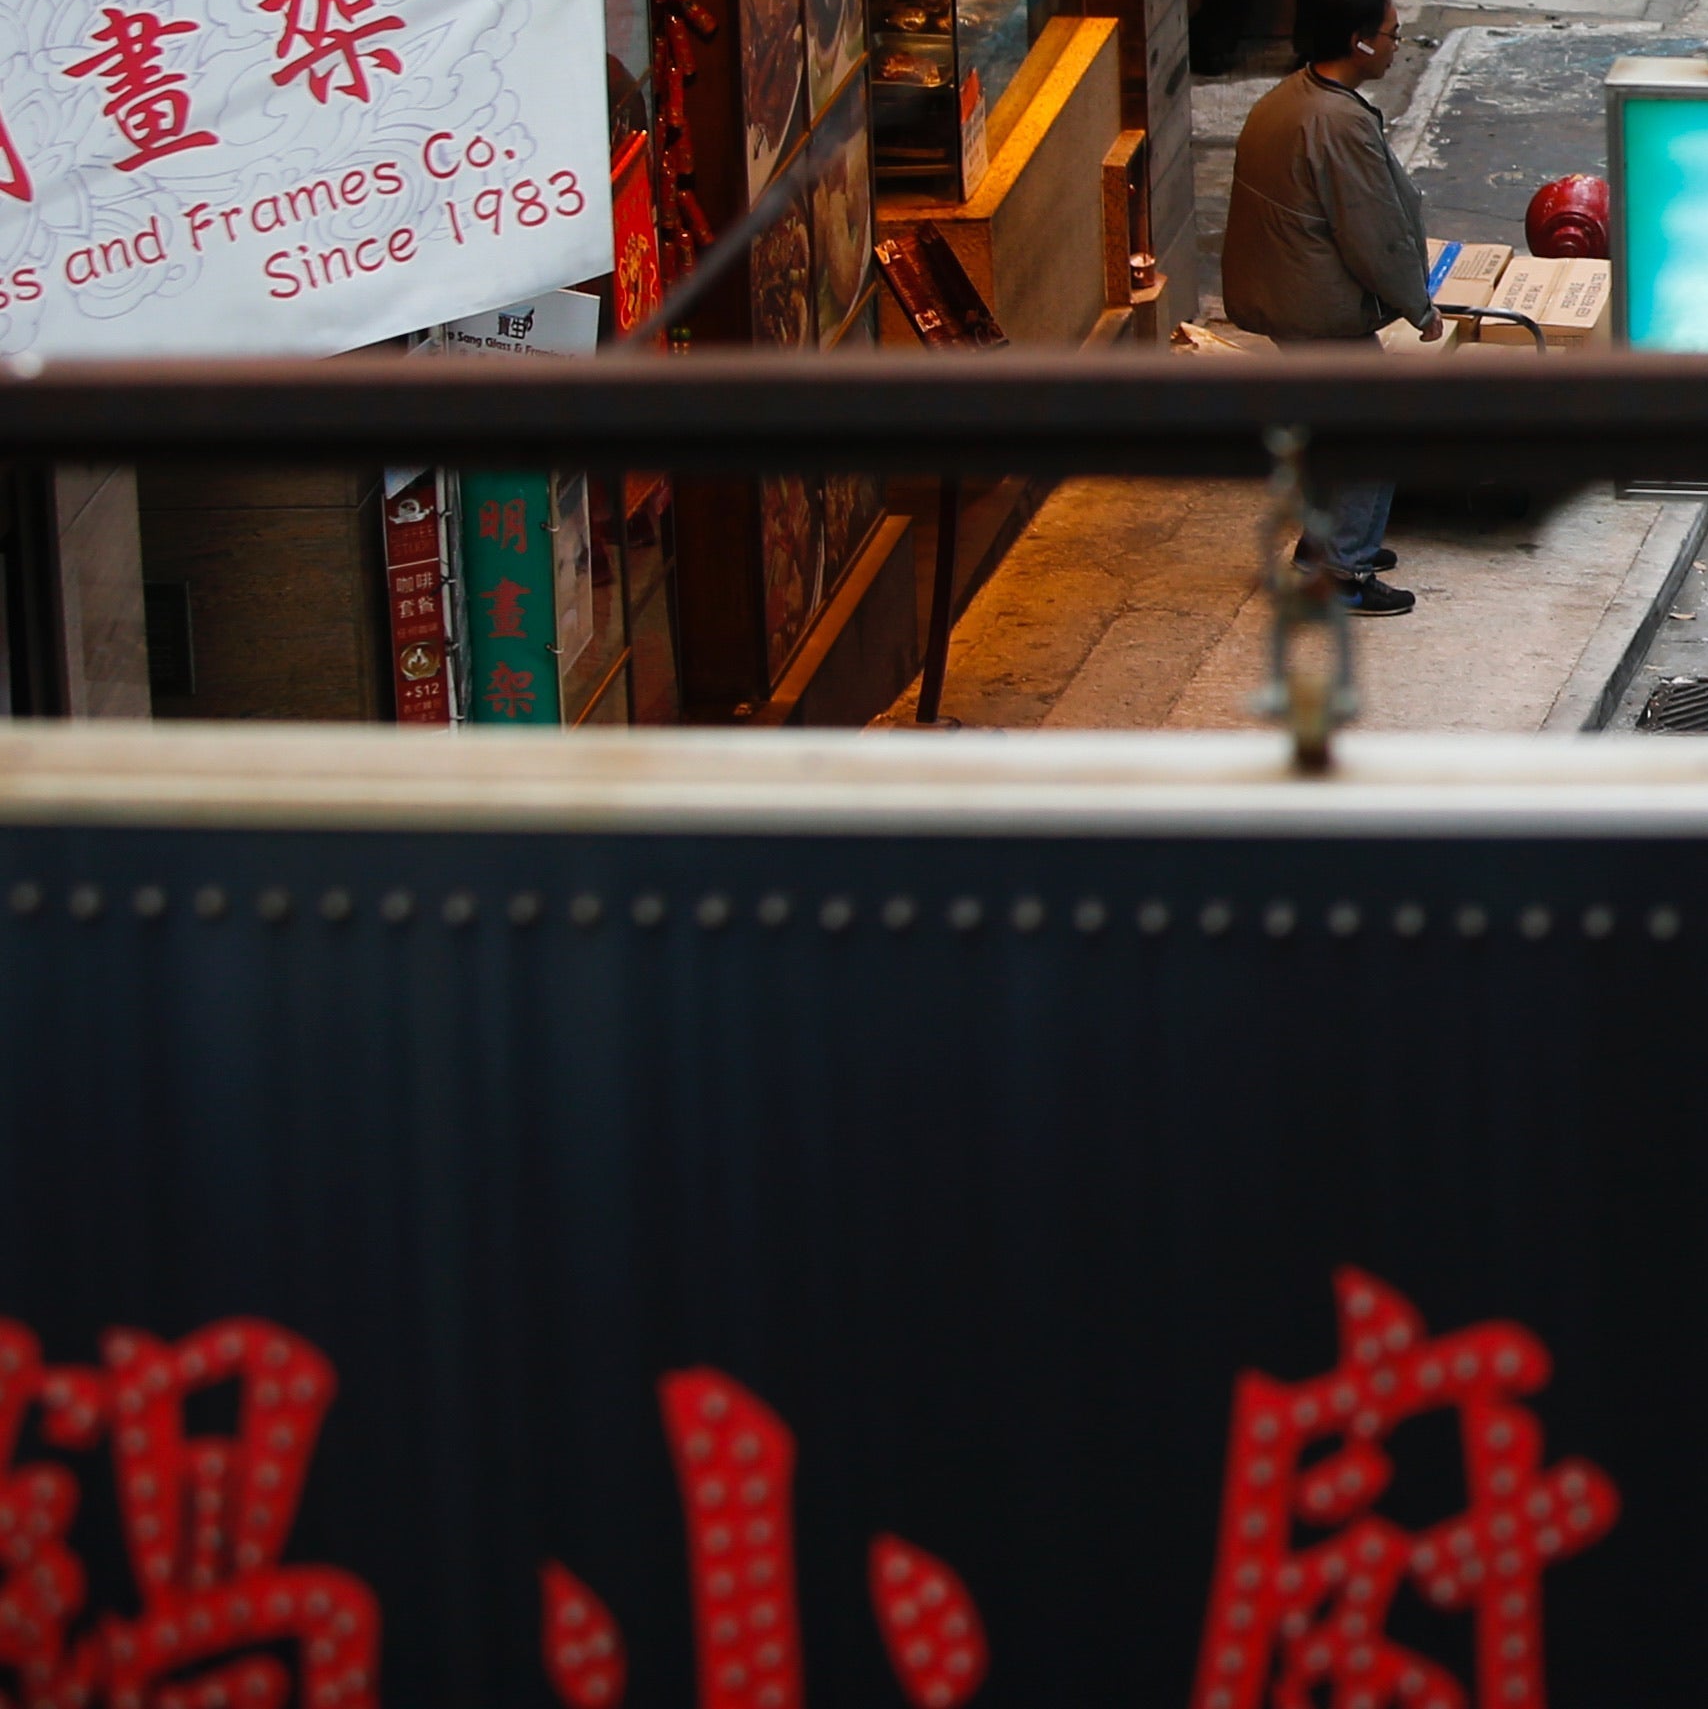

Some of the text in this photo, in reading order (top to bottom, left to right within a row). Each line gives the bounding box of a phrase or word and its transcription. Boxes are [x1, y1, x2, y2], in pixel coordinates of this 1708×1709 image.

[64, 216, 167, 285] and
[184, 159, 403, 253] Frames
[421, 131, 516, 181] Co.
[262, 170, 587, 300] Since 1983
